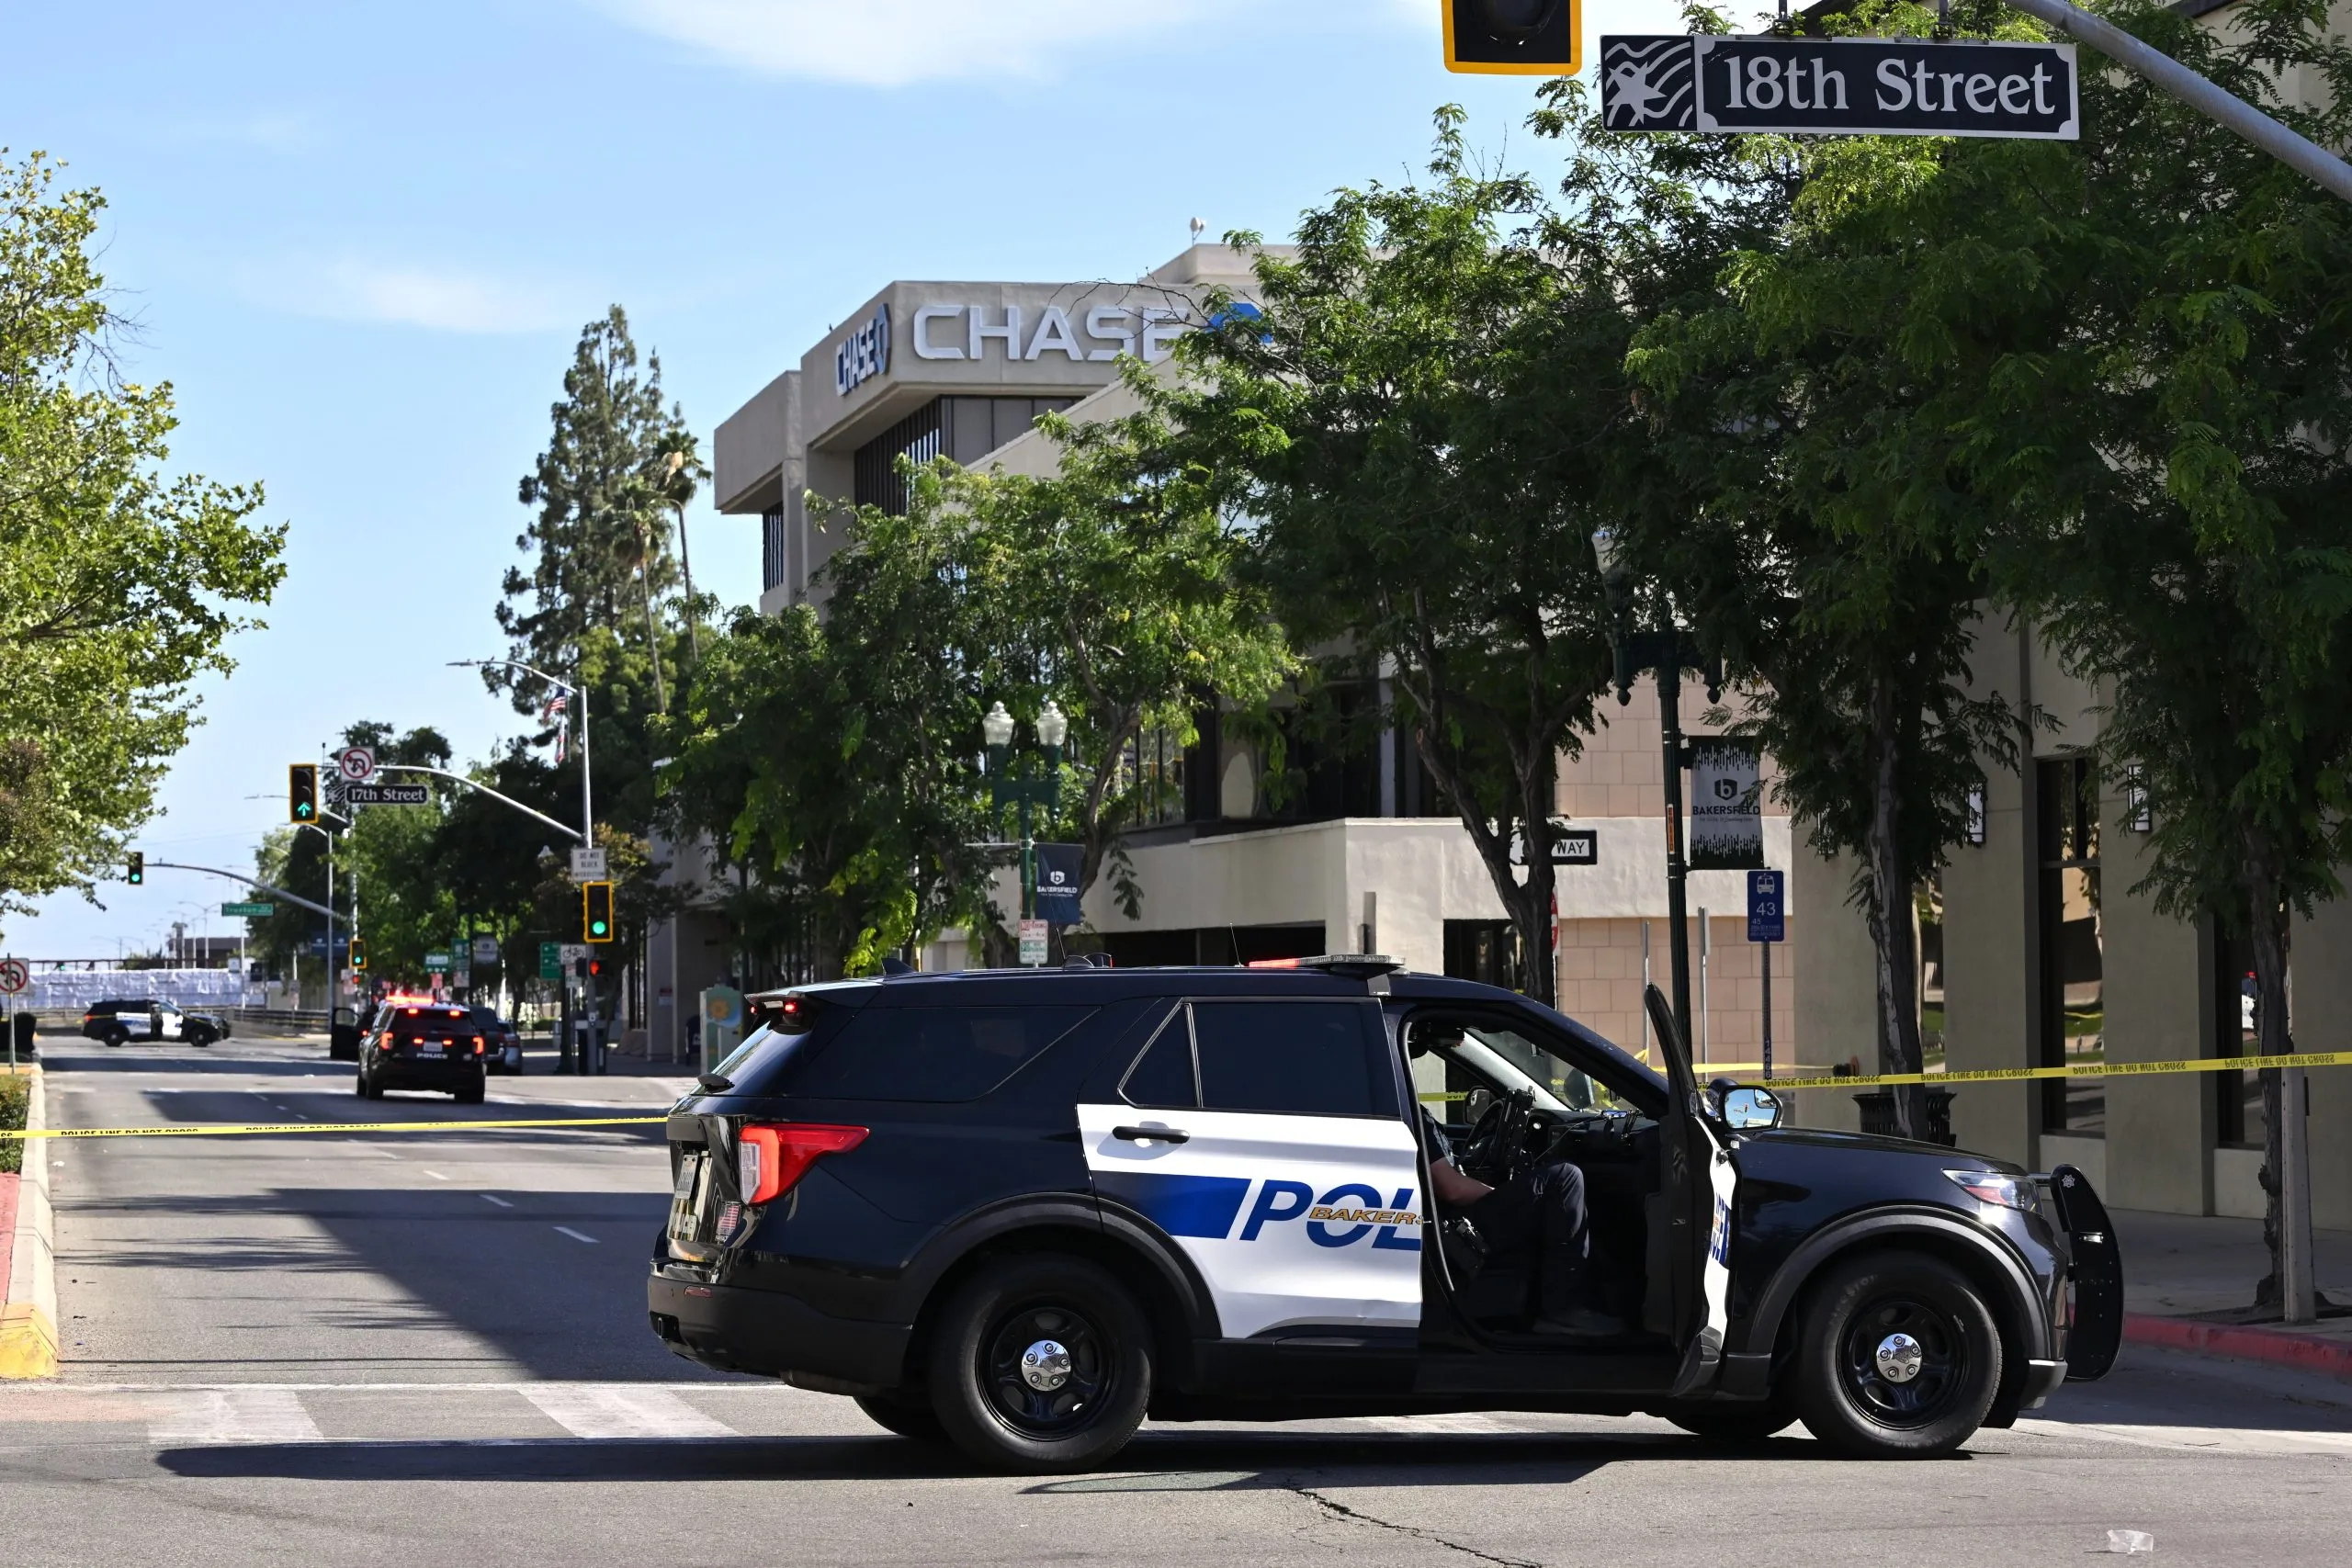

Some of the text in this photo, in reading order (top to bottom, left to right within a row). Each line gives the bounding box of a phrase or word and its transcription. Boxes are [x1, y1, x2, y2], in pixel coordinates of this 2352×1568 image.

[1724, 55, 2056, 114] 18th Street
[913, 304, 1187, 362] CHASE
[835, 318, 876, 396] CHASE
[351, 788, 424, 802] 17th Street
[1557, 841, 1584, 854] WAY
[1756, 902, 1776, 916] 43
